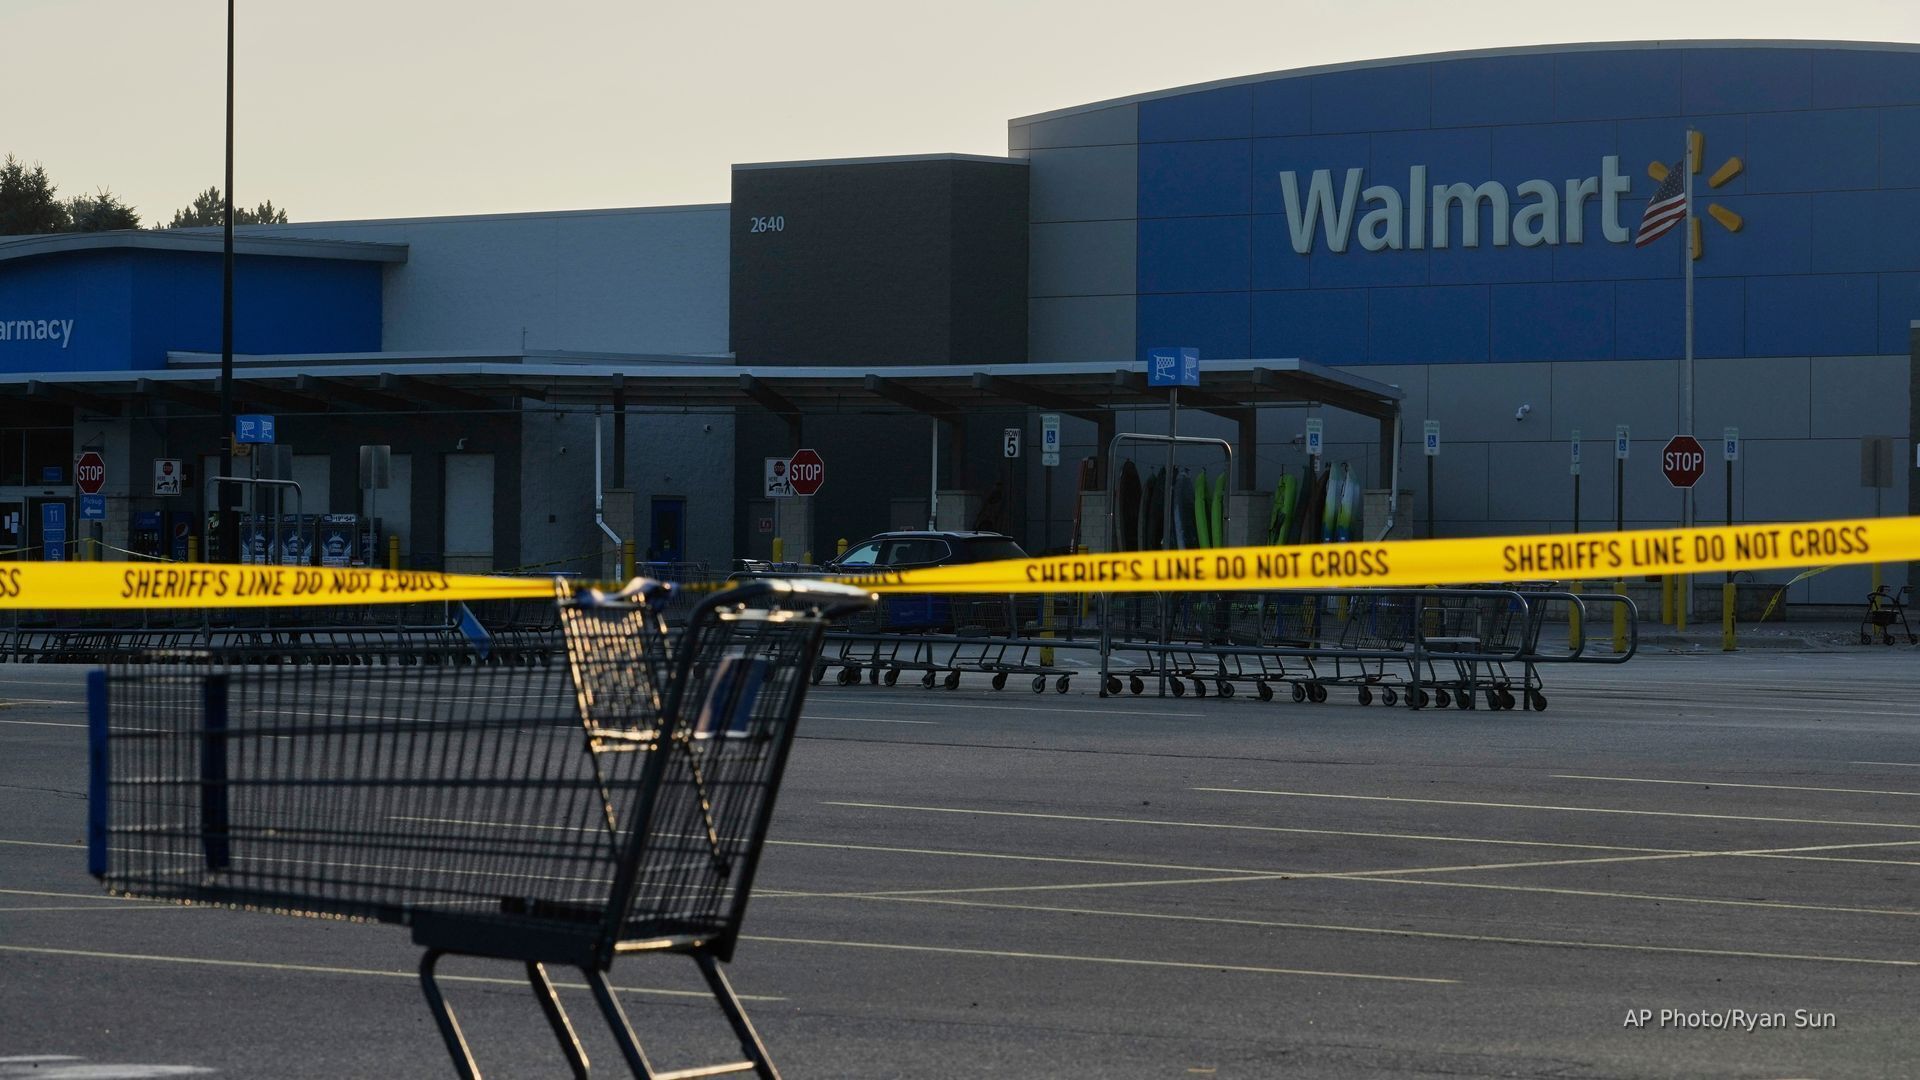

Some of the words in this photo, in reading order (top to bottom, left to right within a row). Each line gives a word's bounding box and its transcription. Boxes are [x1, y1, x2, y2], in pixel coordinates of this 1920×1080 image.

[1279, 155, 1631, 254] Walmart
[750, 216, 785, 233] 2640
[1007, 437, 1016, 457] 5
[1664, 452, 1702, 472] STOP
[79, 466, 104, 481] STOP
[791, 464, 821, 481] STOP
[83, 496, 104, 506] Pickup
[49, 510, 58, 522] 11
[1503, 540, 1622, 573] SHERIFF'S
[1631, 536, 1685, 567] LINE
[1694, 534, 1725, 563] DO
[1735, 530, 1780, 561] NOT
[1790, 526, 1869, 558] CROSS
[1025, 559, 1143, 582] SHERIFF'S
[1153, 556, 1206, 581] LINE
[1216, 555, 1247, 580] DO
[1256, 552, 1302, 579] NOT
[1311, 549, 1390, 578] CROSS
[122, 569, 230, 598] SHERIFF'S
[236, 570, 286, 596] LINE
[292, 570, 324, 596] DO
[329, 571, 372, 595] NOT
